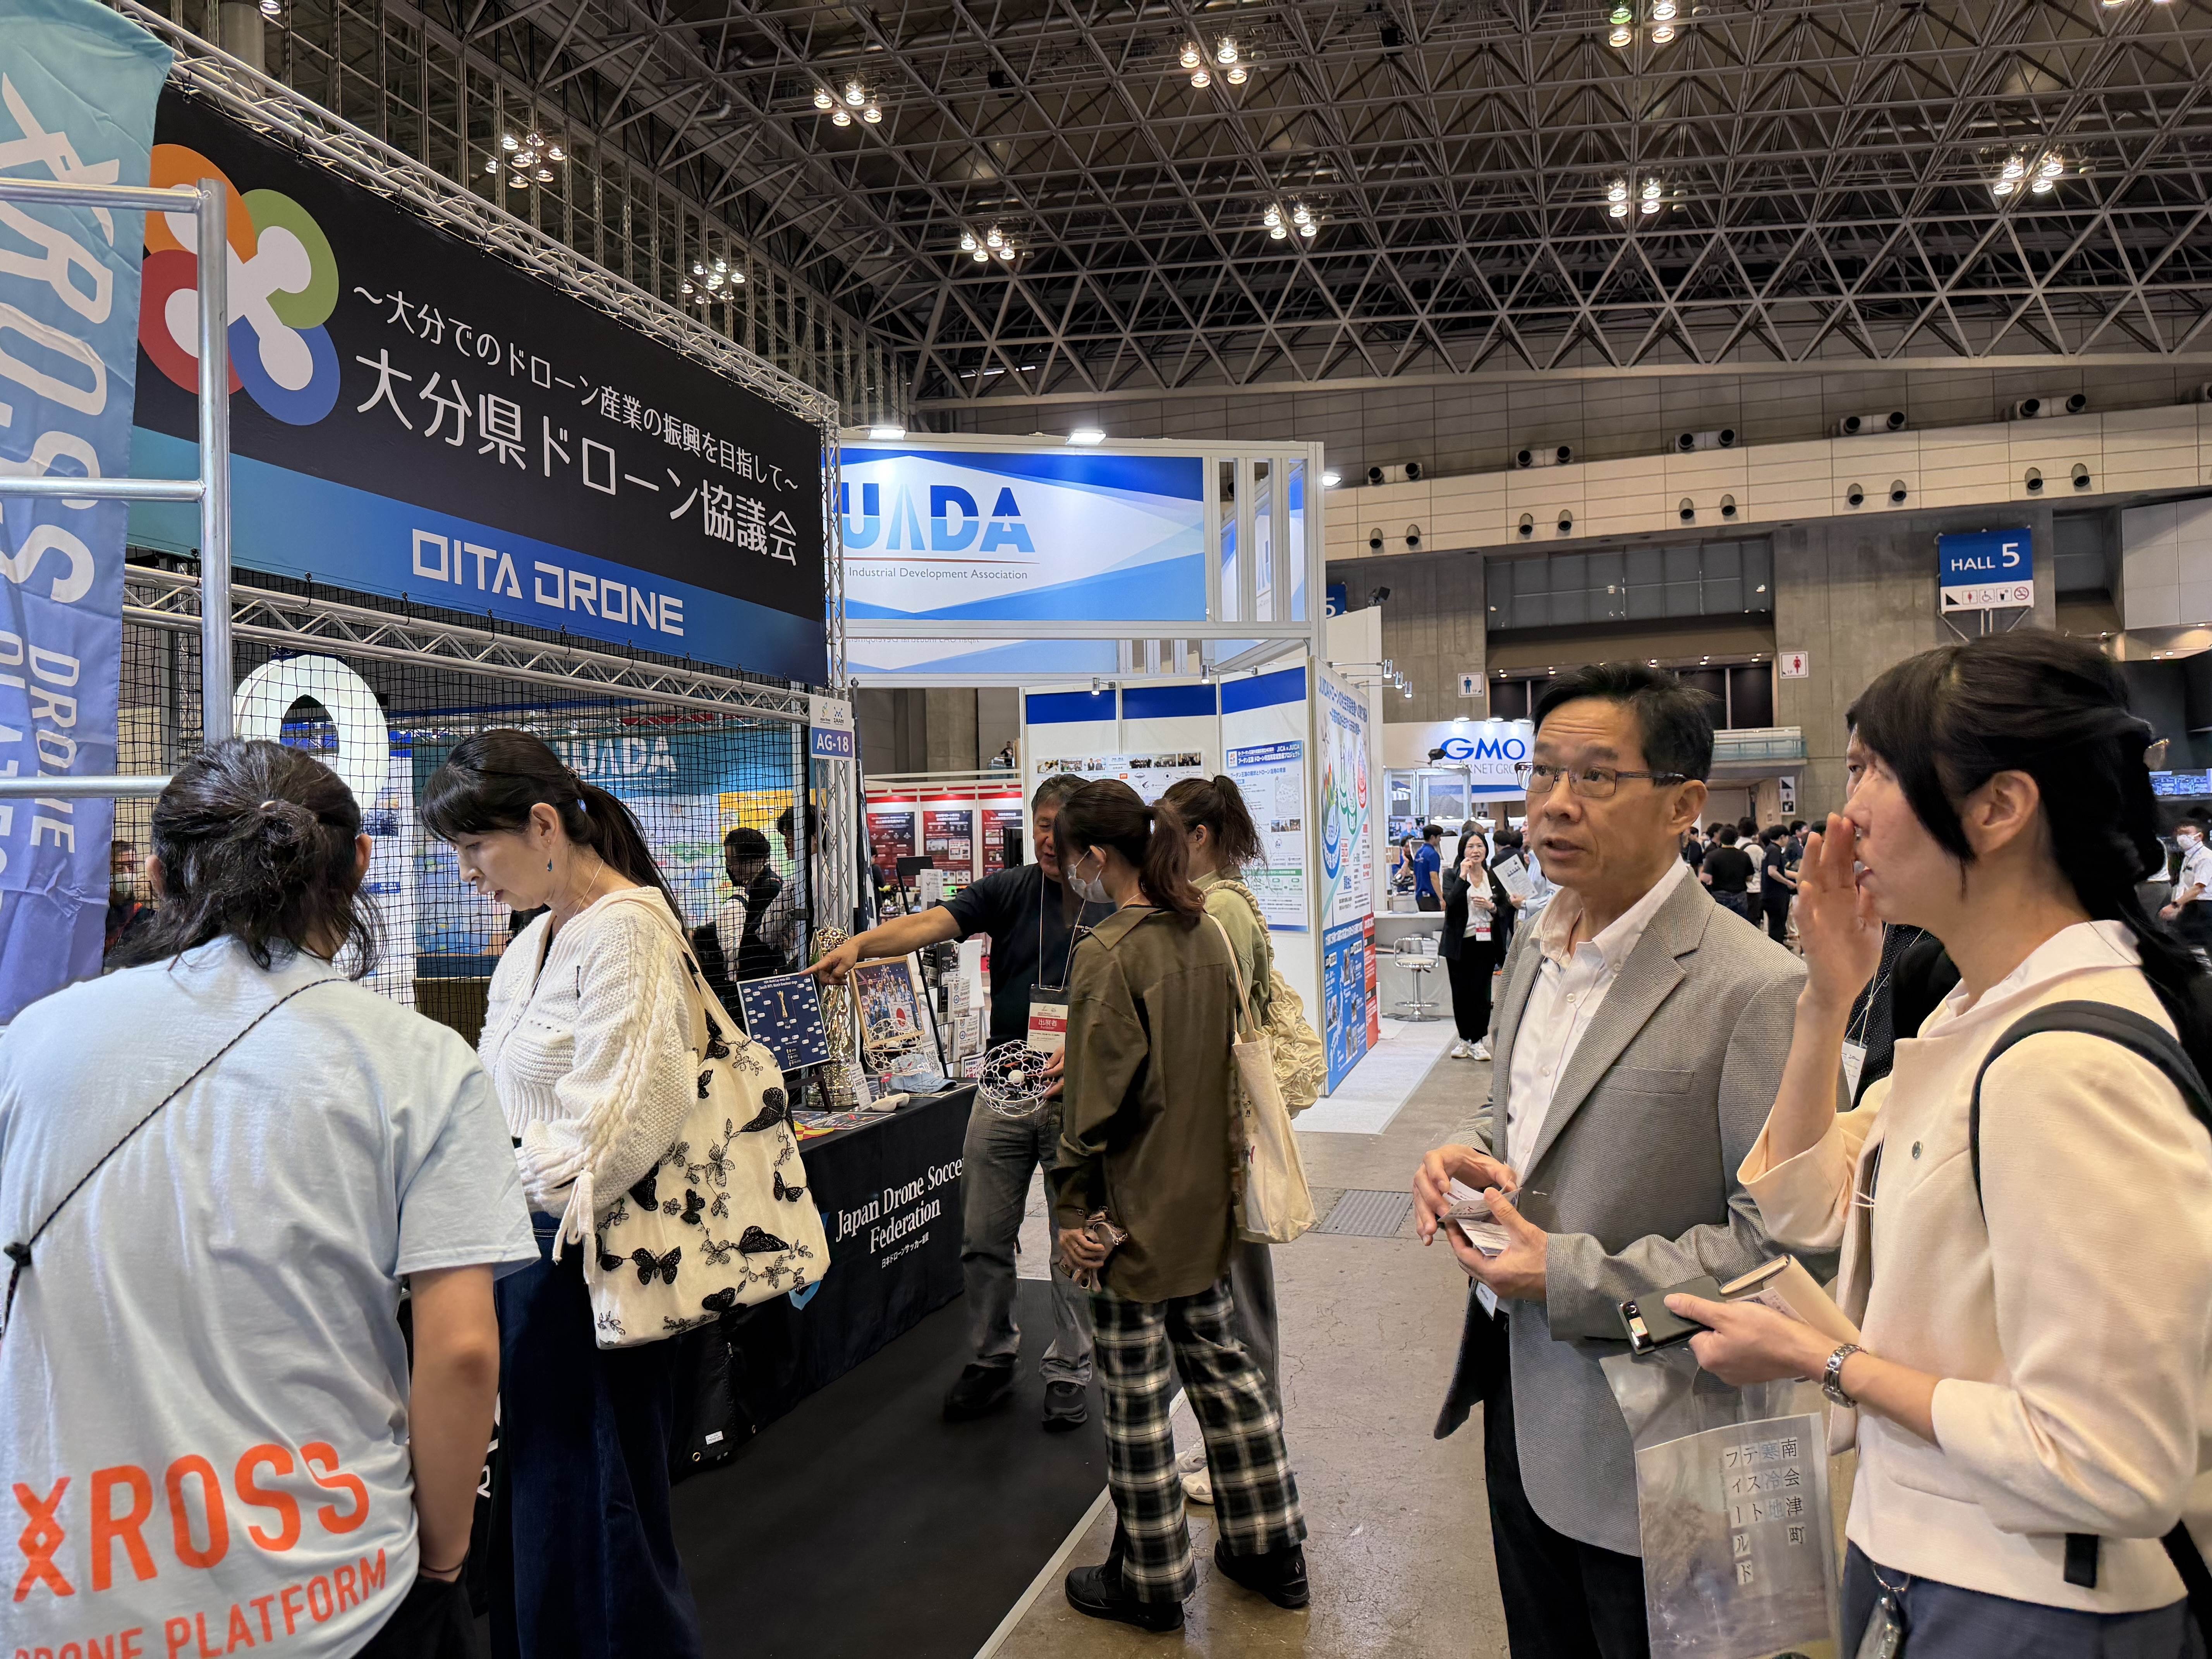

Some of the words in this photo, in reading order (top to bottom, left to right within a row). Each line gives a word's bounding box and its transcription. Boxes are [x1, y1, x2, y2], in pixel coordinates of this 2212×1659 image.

[355, 349, 797, 566] 大分県ドローン協議会
[412, 529, 523, 599] OITA
[535, 563, 684, 636] DRONE
[849, 567, 895, 577] Industrial
[900, 568, 967, 580] Development
[971, 569, 1027, 579] Association
[1951, 557, 1996, 572] HALL
[2002, 542, 2020, 568] 5
[817, 733, 849, 752] AG-18
[1441, 737, 1525, 760] GMO
[836, 1200, 880, 1242] Japan
[883, 1177, 924, 1215] Drone
[928, 1158, 963, 1190] Socce
[870, 1199, 941, 1254] Federation
[12, 1441, 370, 1603] XROSS
[1725, 1450, 1752, 1583] フィールド
[1743, 1447, 1762, 1522] テスト
[1781, 1437, 1805, 1545] 南会津町
[165, 1548, 386, 1659] PLATFORM
